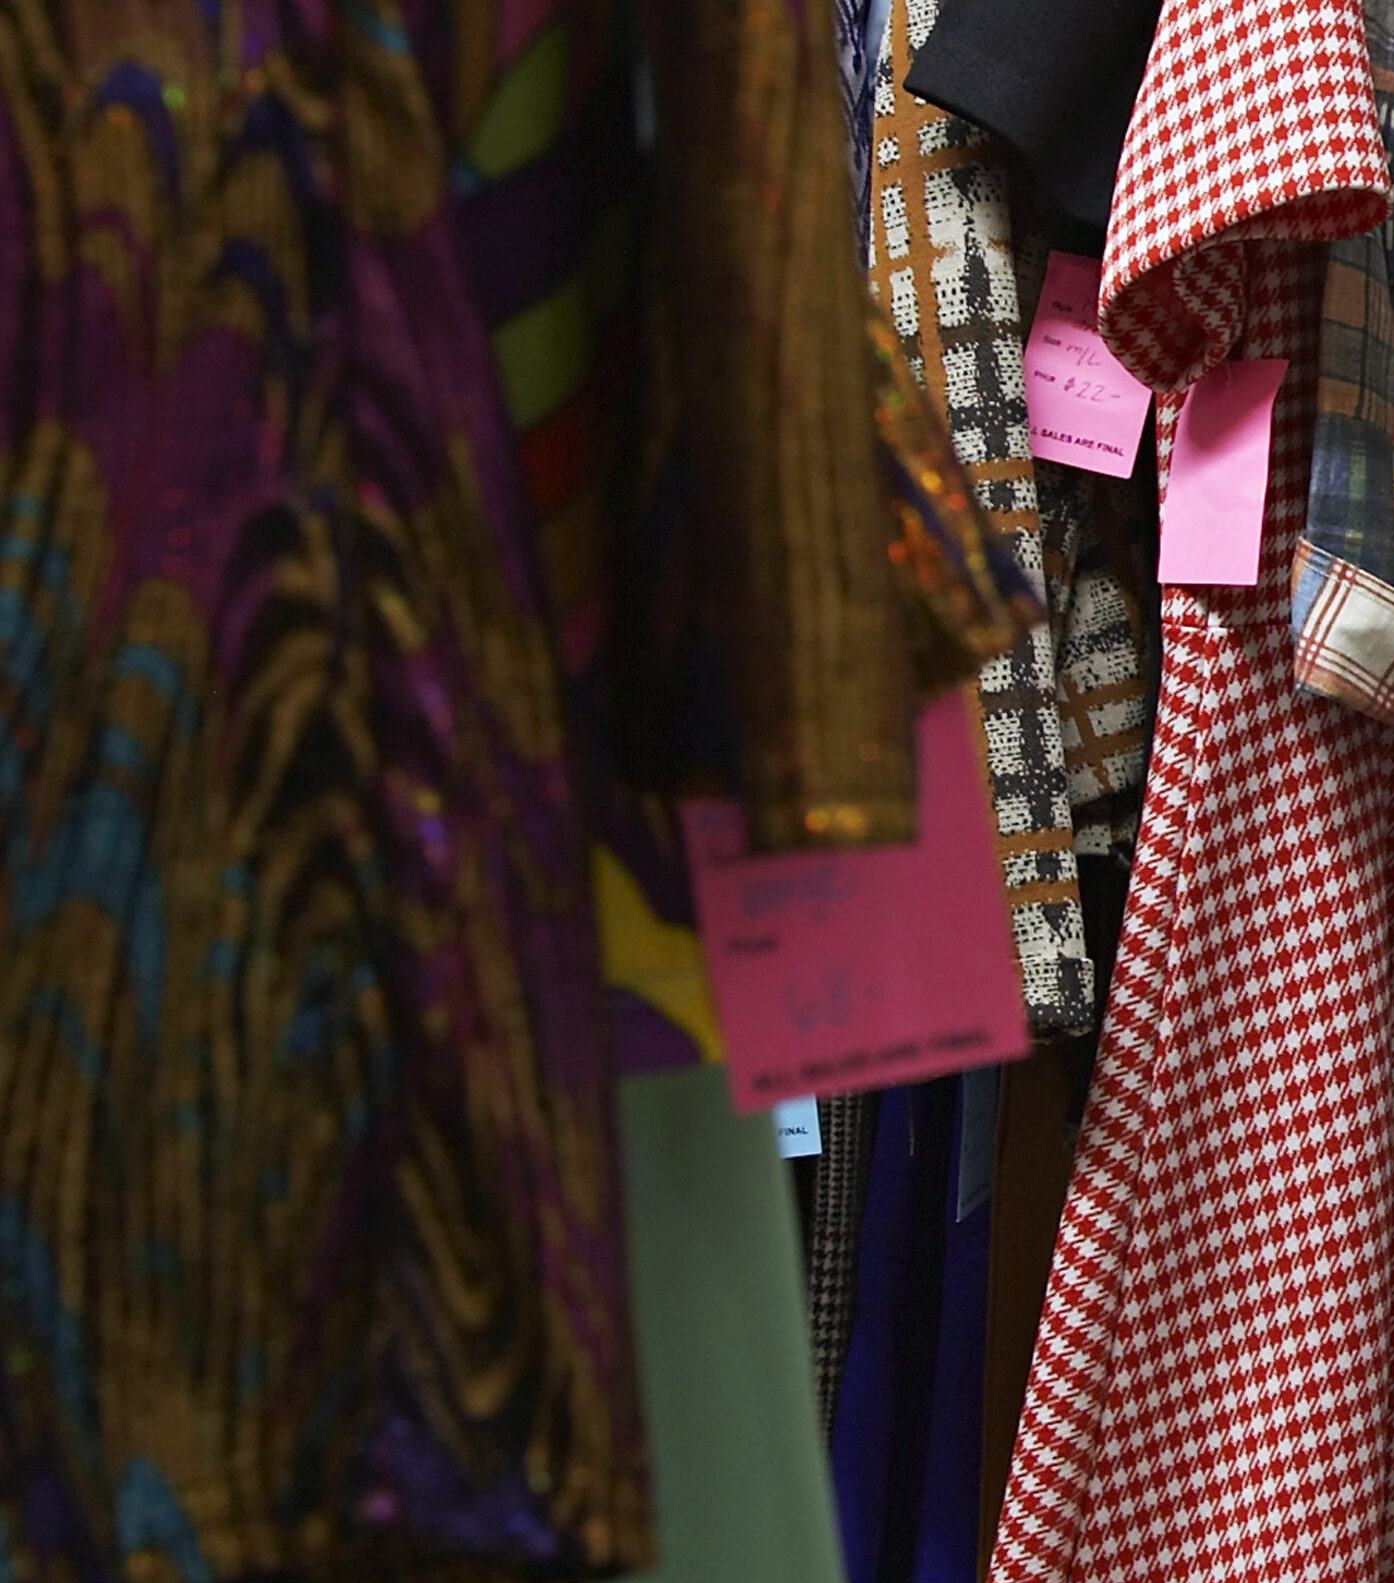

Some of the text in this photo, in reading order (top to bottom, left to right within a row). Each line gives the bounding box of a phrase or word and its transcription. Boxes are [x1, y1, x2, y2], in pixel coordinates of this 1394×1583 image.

[1040, 427, 1073, 444] SALES
[1074, 437, 1095, 449] ARE
[1096, 442, 1125, 457] FINAL
